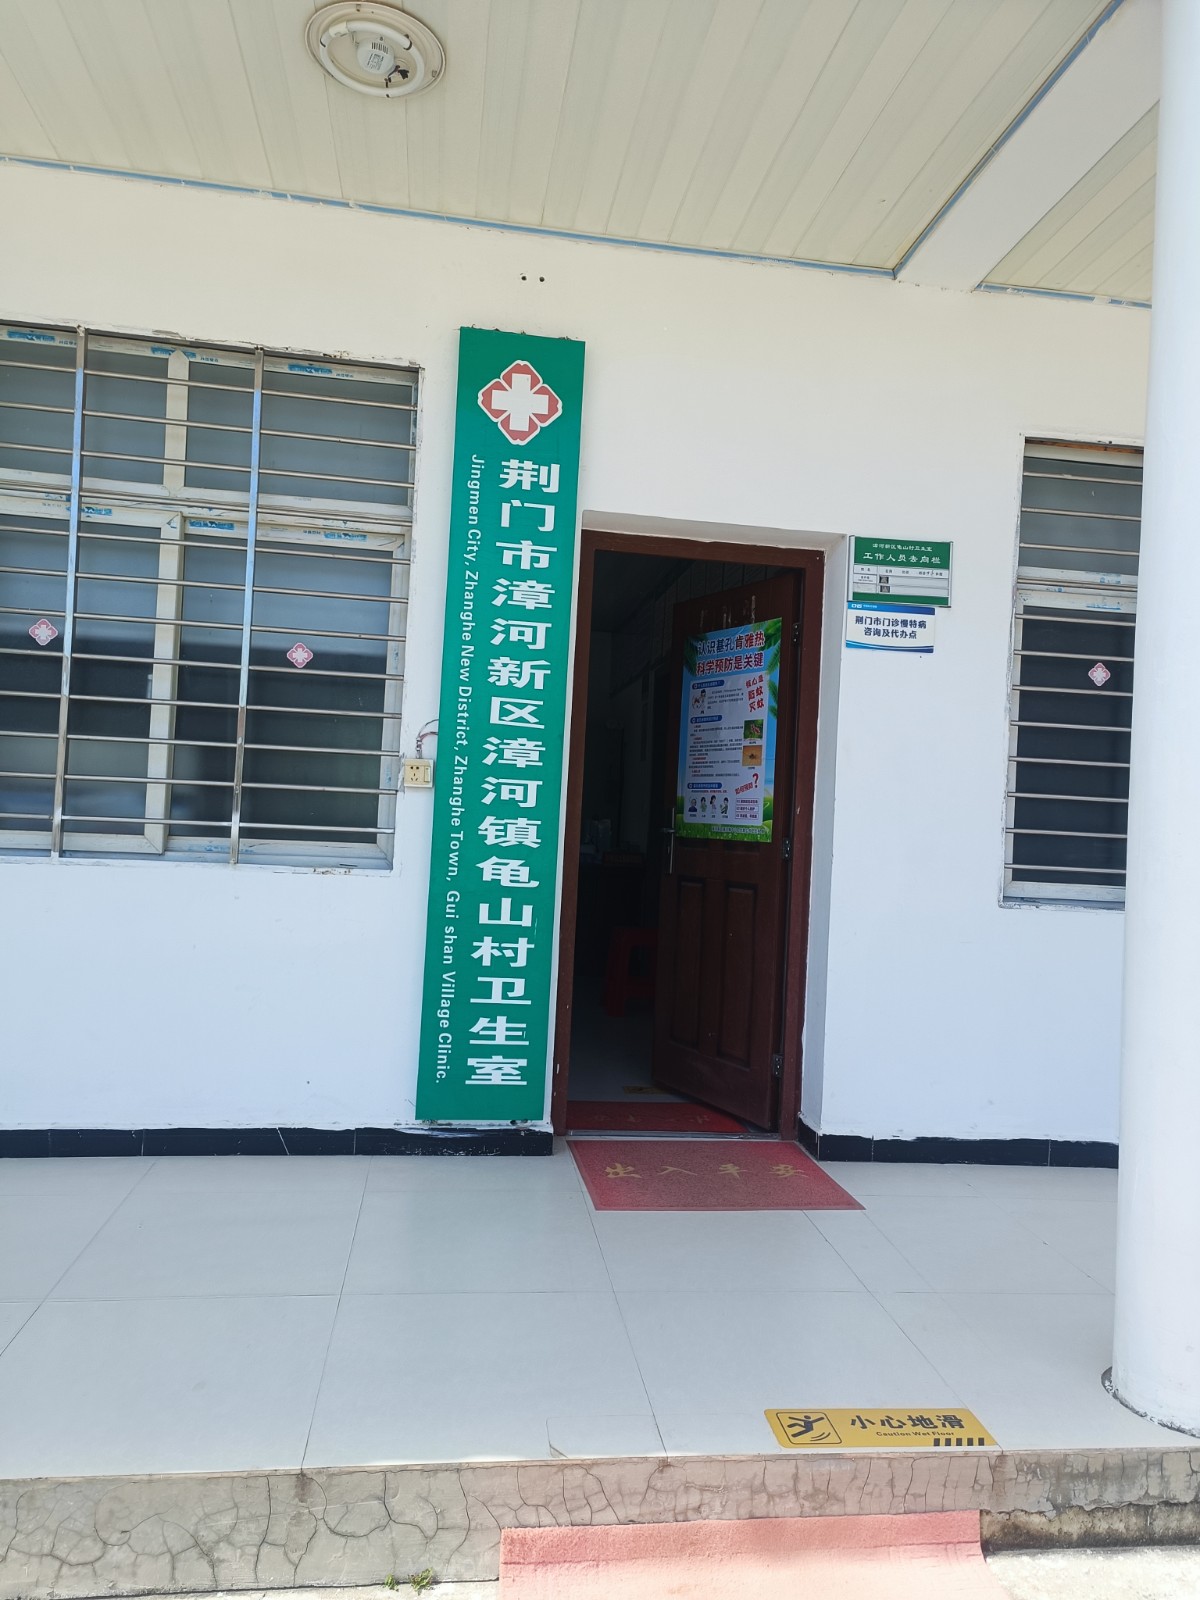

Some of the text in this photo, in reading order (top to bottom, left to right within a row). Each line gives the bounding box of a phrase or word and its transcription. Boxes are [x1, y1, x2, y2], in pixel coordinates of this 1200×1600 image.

[862, 552, 942, 564] 工作人员去向栏
[855, 615, 927, 629] 荆门市门诊慢特病
[863, 627, 918, 640] 咨询及代办点
[697, 630, 766, 656] 认识基孔肯雅热
[696, 652, 764, 676] 科学预防是关键
[435, 454, 485, 1084] Jingmen City, Zhanghe New District, Zhanghe Town, Gui shan Village Clinic.
[465, 458, 561, 1086] 荆门市漳河新区漳河镇龟山村卫生室
[603, 1162, 810, 1180] 出入平安
[850, 1414, 966, 1430] 小心地滑
[875, 1430, 912, 1438] Caution
